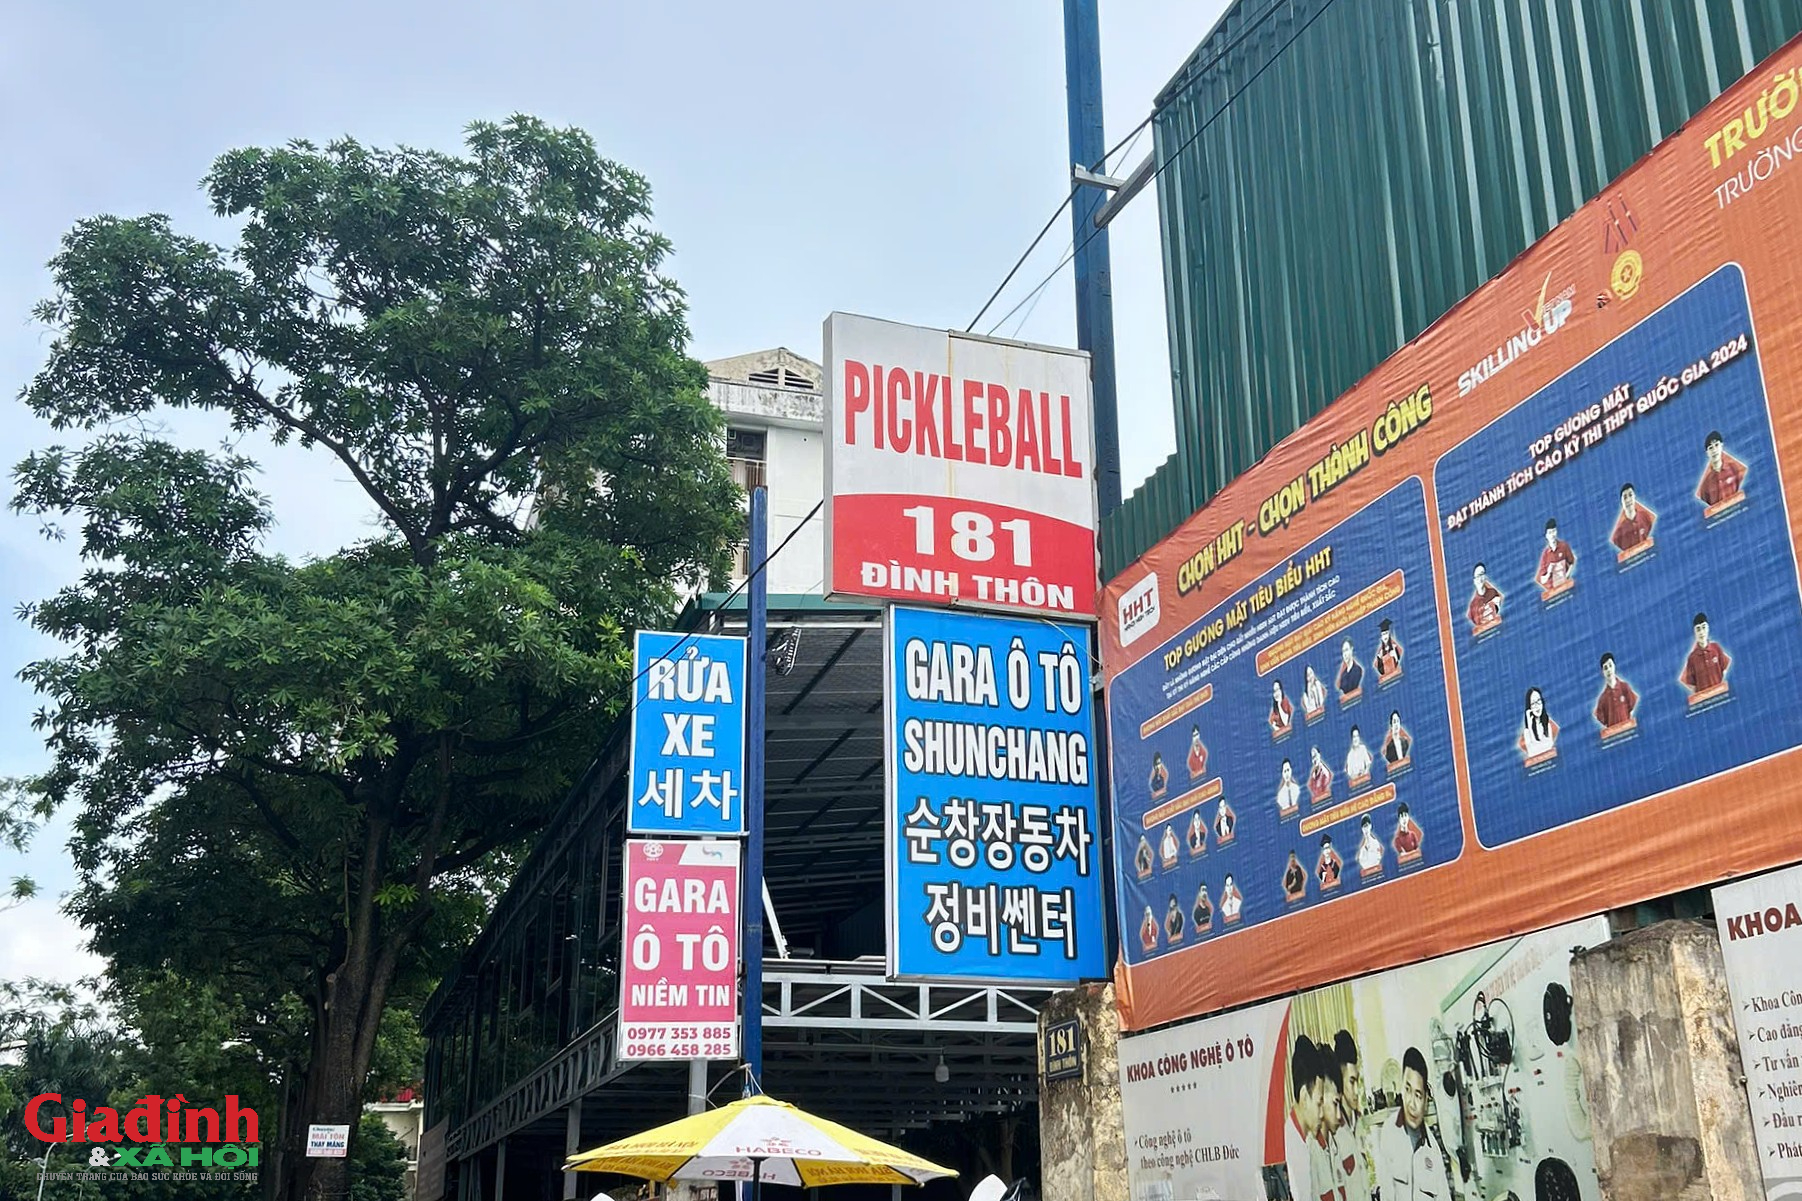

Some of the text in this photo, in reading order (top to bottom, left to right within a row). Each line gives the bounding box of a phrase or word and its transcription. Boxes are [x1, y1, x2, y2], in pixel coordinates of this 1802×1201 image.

[1704, 66, 1802, 169] TRƯỜ
[1458, 300, 1573, 398] SKILLING UP
[844, 358, 1083, 479] PICKLEBALL
[1447, 505, 1468, 529] ĐẠT
[1469, 490, 1506, 516] THÀNH
[1506, 471, 1534, 494] TÍCH
[1534, 449, 1562, 475] CAO
[1582, 423, 1603, 447] THI
[1603, 403, 1635, 435] THPT
[1636, 376, 1680, 414] QUỐC
[1681, 359, 1710, 386] GIA
[1710, 333, 1748, 369] 2024
[1529, 383, 1630, 458] TOP GƯƠNG MẶT
[1178, 540, 1217, 593] CHỌN
[1215, 518, 1245, 565] HHT
[1258, 474, 1306, 534] CHỌN
[1308, 427, 1370, 500] THÀNH
[1372, 383, 1433, 453] CÔNG
[903, 505, 1032, 567] 181
[860, 559, 1075, 610] ĐÌNH THÔN
[1123, 587, 1154, 625] HHT
[1163, 646, 1183, 671] TOP
[1184, 619, 1224, 657] GƯƠNG
[1225, 600, 1248, 630] MẶT
[1248, 584, 1274, 614] TIÊU
[1275, 559, 1303, 598] BIỂU
[1305, 545, 1332, 579] HHT
[648, 645, 734, 704] RỬA
[904, 638, 999, 707] GARA
[1007, 637, 1031, 711] Ô
[1039, 642, 1082, 715] TÔ
[660, 712, 716, 758] XE
[903, 717, 1090, 785] SHUNCHANG
[638, 768, 739, 821] 세차
[905, 797, 1092, 876] 순창장동차
[634, 877, 730, 914] GARA
[925, 881, 1076, 960] 정비쎈터
[1727, 902, 1802, 942] KHOA
[632, 923, 730, 972] Ô TÔ
[631, 977, 730, 1007] NIỀM TIN
[1751, 995, 1780, 1013] Khoa
[627, 1027, 731, 1040] 0977 353 885
[627, 1043, 731, 1057] 0966 458 285
[1049, 1025, 1076, 1058] 181
[1757, 1026, 1778, 1043] Cao
[1126, 1034, 1255, 1083] KHOA CÔNG NGHỆ Ô TÔ
[1762, 1048, 1800, 1072] Tư vấn
[1138, 1134, 1158, 1151] Công
[1158, 1130, 1177, 1149] nghệ
[1183, 1128, 1192, 1143] tô
[1772, 1107, 1795, 1129] Đầu
[735, 1146, 822, 1157] HABECO
[1140, 1155, 1156, 1170] theo
[1157, 1152, 1175, 1170] công
[1195, 1145, 1221, 1164] CHLB
[1222, 1144, 1240, 1161] Đức
